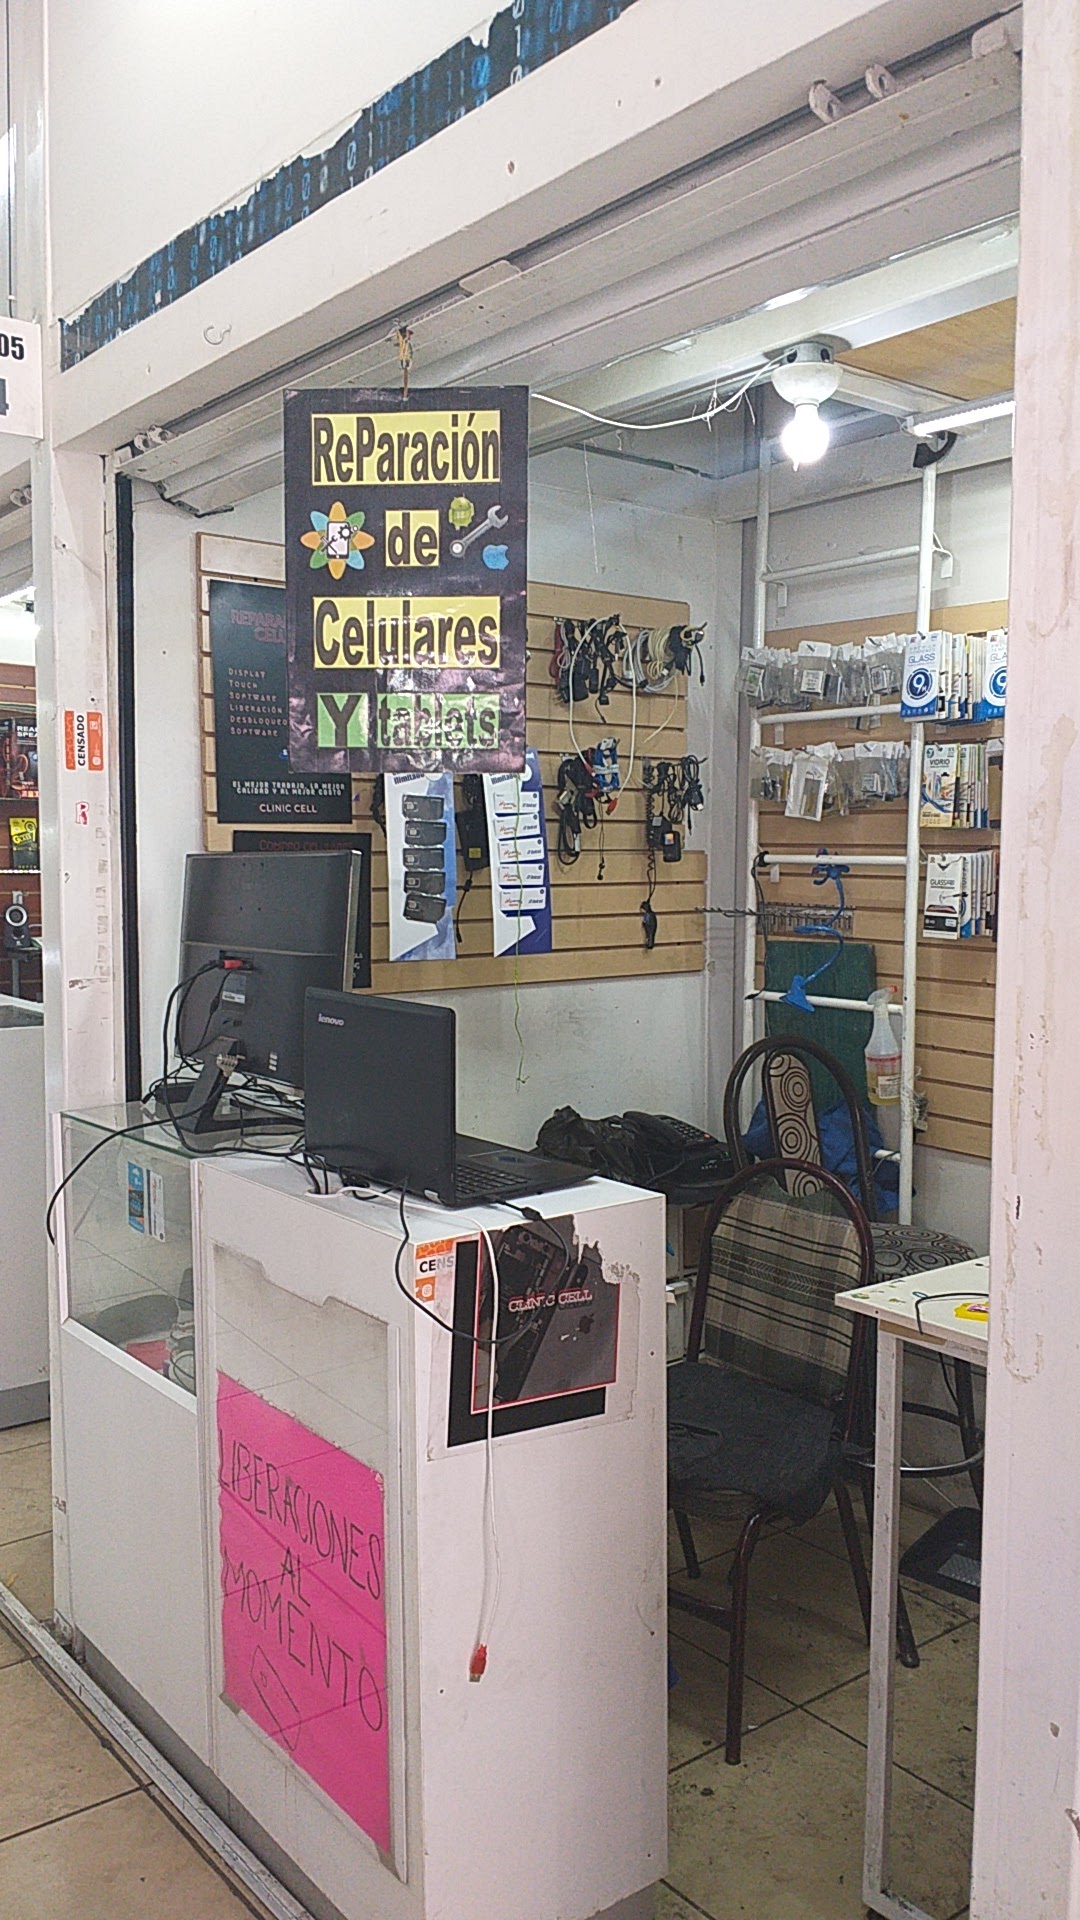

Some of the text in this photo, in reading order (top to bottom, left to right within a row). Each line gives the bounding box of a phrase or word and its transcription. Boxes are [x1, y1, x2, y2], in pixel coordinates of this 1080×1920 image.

[387, 512, 439, 566] de
[231, 609, 286, 629] REPARA
[314, 600, 499, 666] Celulares
[908, 652, 936, 664] GLASS
[228, 679, 258, 689] TOUCH
[229, 691, 277, 702] SOFTWARE
[229, 715, 288, 726] DESBLOQUEO
[319, 694, 497, 749] Y tablets
[230, 727, 278, 737] SOFTWARE
[76, 714, 86, 767] CENSADO
[929, 758, 951, 766] VIDRIO
[232, 780, 241, 788] EL
[310, 782, 319, 790] LA
[236, 787, 270, 795] CALIDAD
[318, 788, 342, 796] COSTO
[259, 803, 317, 813] CLINIC CELL
[318, 1013, 345, 1026] lenovo
[508, 1294, 556, 1313] CLINC
[218, 1428, 383, 1601] LIBERACIONES
[280, 1546, 312, 1607] AL
[221, 1544, 383, 1732] MOMENTO
